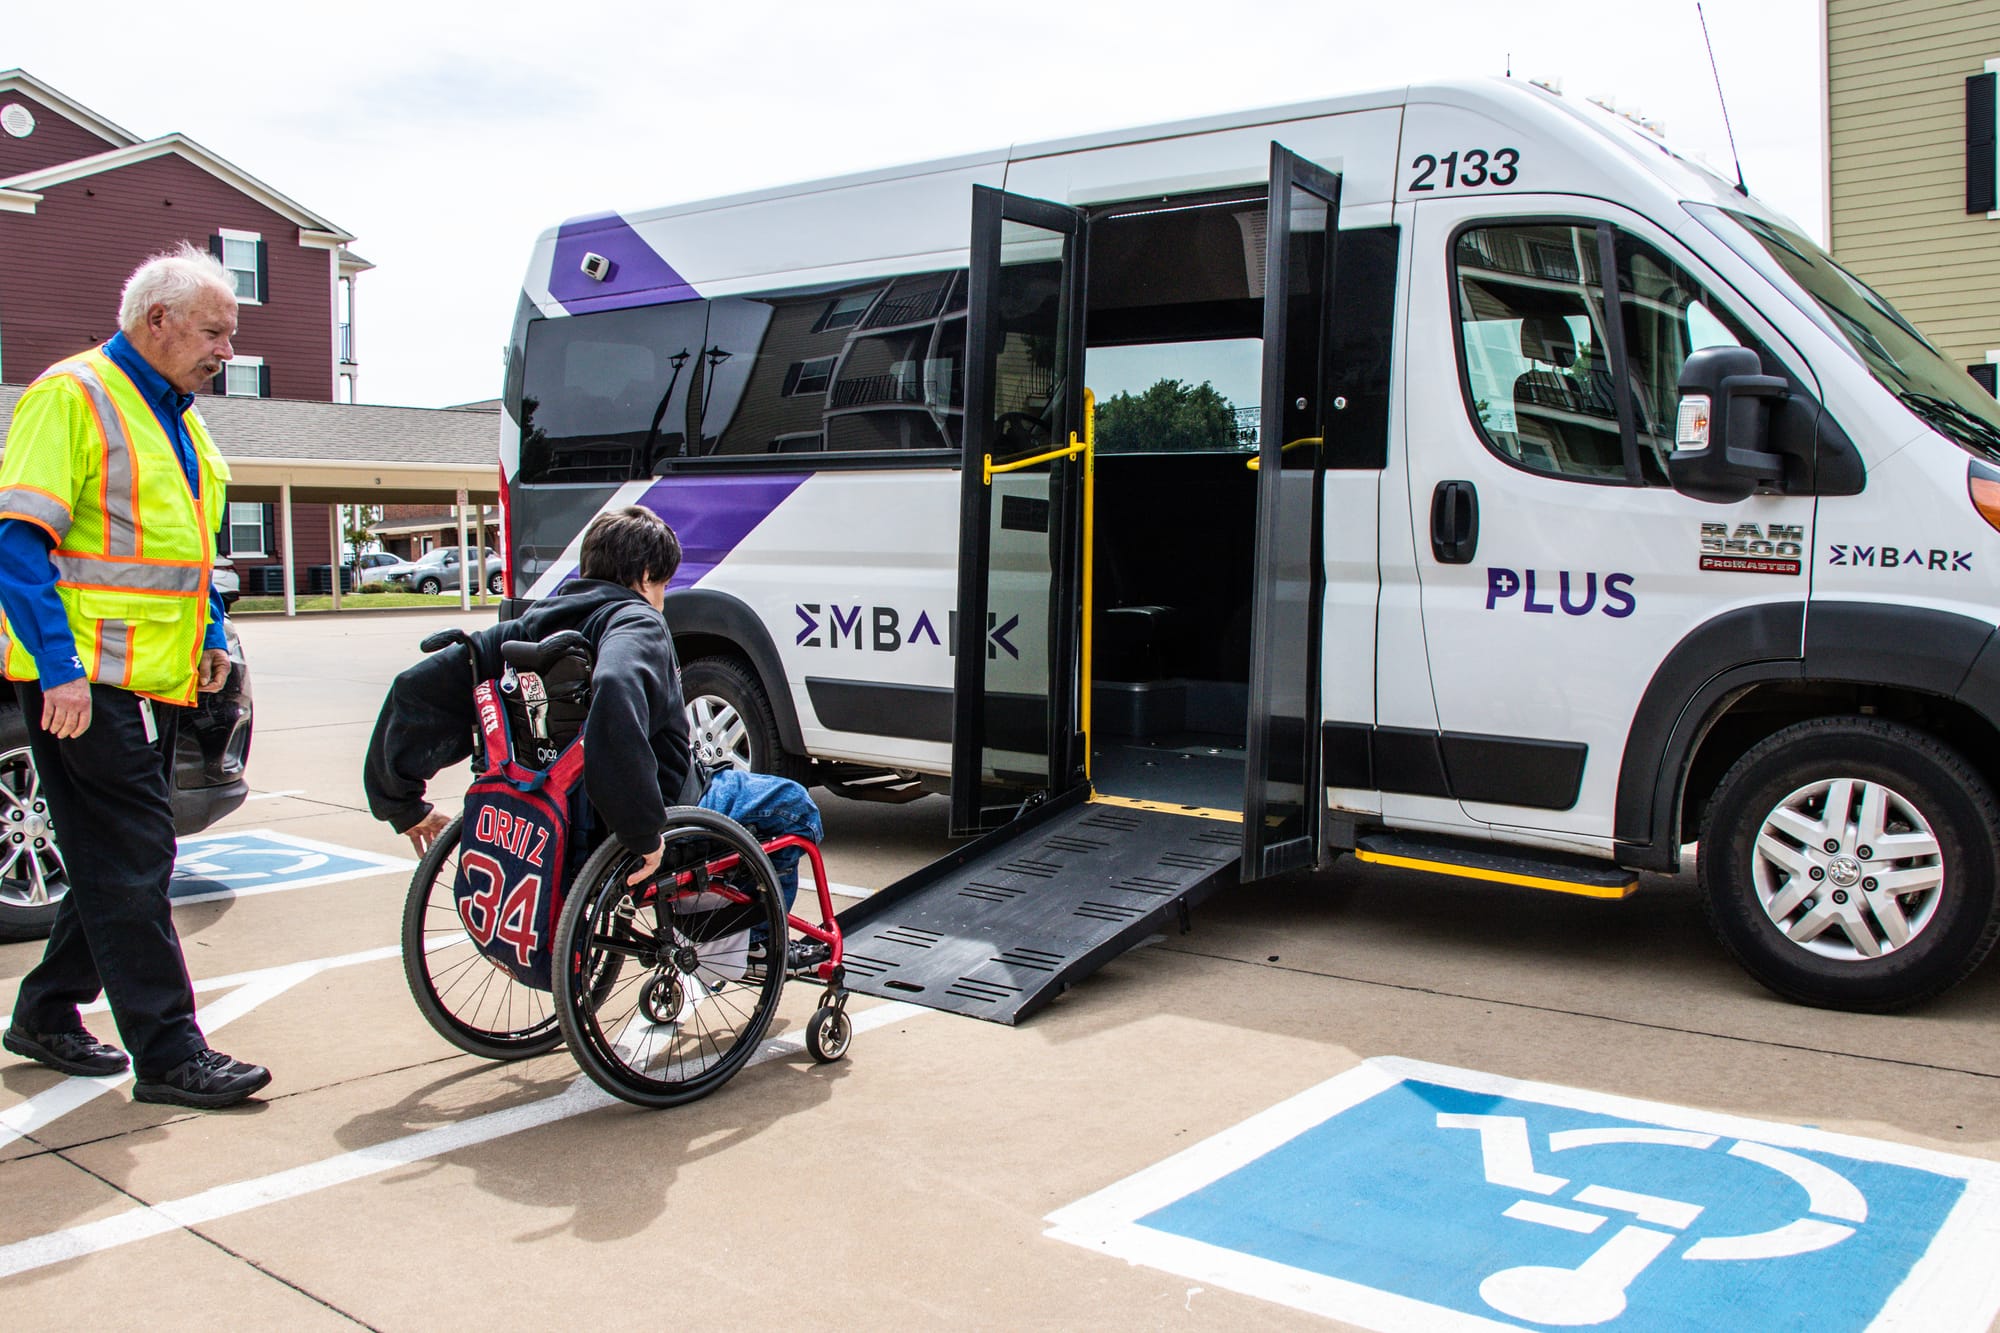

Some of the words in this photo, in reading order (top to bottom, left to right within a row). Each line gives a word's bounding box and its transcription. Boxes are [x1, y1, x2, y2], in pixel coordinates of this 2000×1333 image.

[1408, 147, 1520, 192] 2133
[1700, 522, 1804, 542] RAM
[1829, 544, 1973, 572] EMBARK
[1485, 567, 1637, 619] PLUS
[796, 603, 1019, 661] EMBAK
[475, 804, 550, 868] ORTIZ
[458, 848, 543, 968] 34
